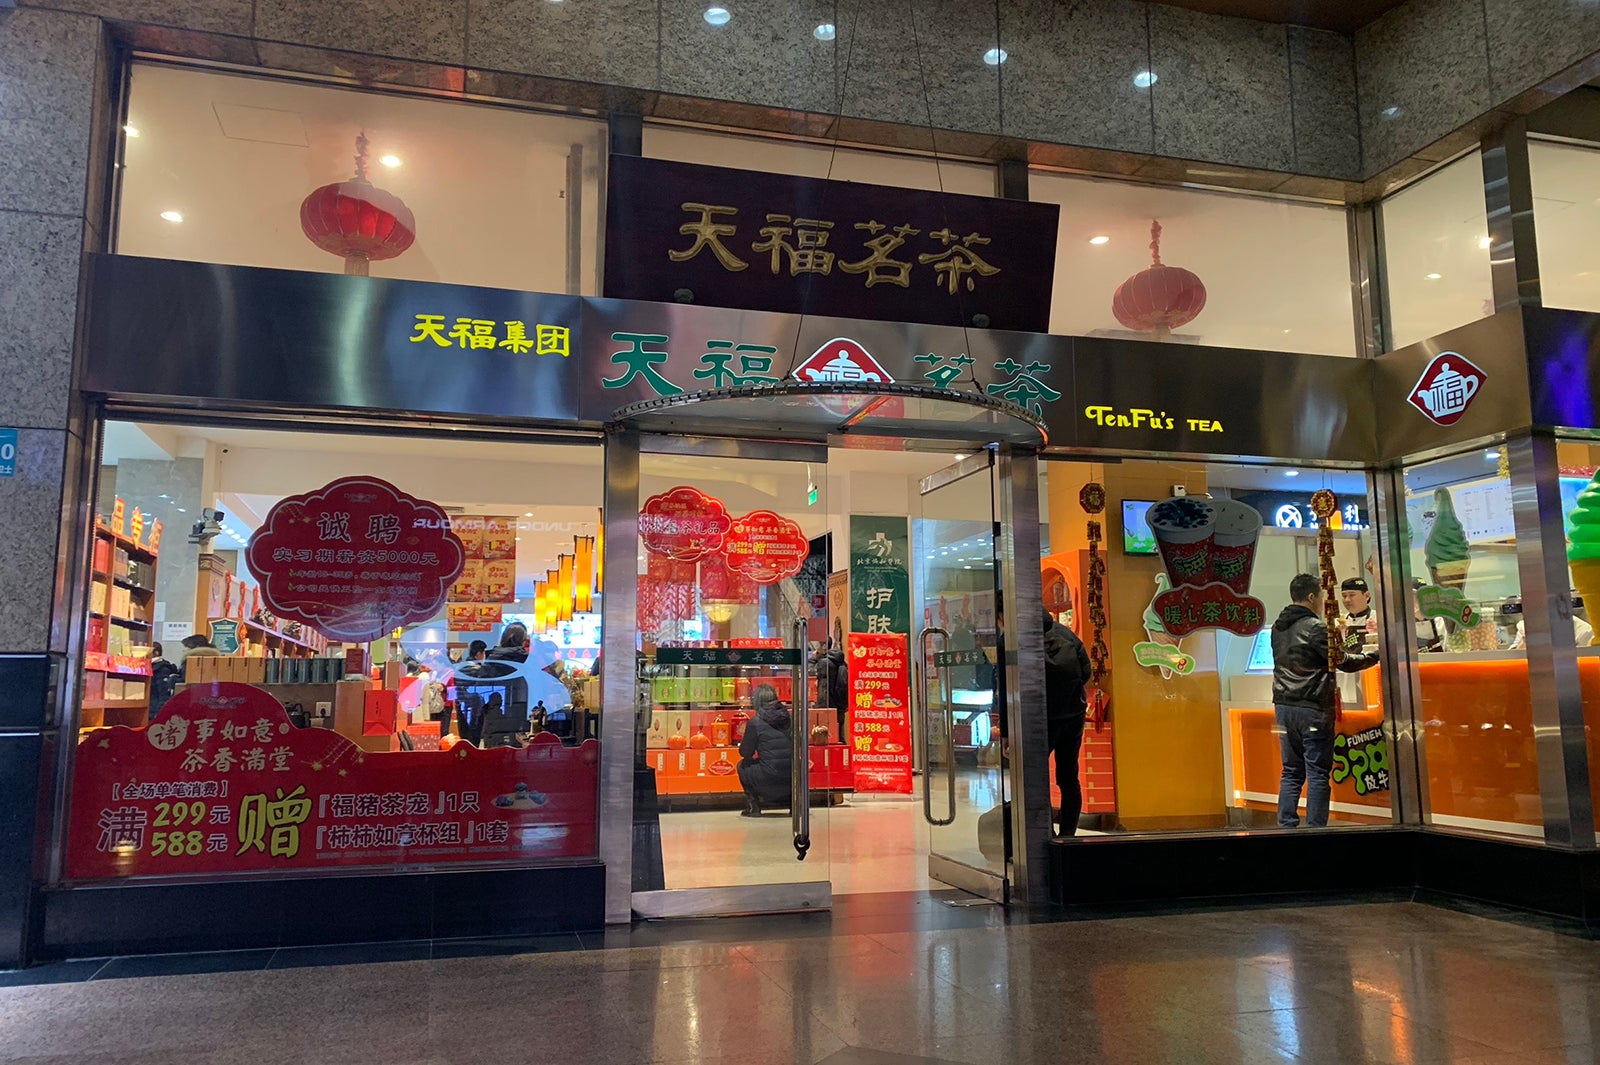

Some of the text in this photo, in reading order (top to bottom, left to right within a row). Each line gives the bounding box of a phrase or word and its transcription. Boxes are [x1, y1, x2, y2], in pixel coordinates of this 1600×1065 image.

[668, 202, 1001, 295] 天福茗茶
[409, 313, 571, 357] 天福集团
[1186, 419, 1223, 432] TEA
[317, 511, 401, 545] 诚聘
[273, 547, 440, 566] 实习期薪资5000元
[1164, 601, 1261, 627] 暖心茶饮料
[180, 746, 294, 773] 茶香满堂
[96, 806, 147, 853] 满
[236, 785, 313, 858] 赠
